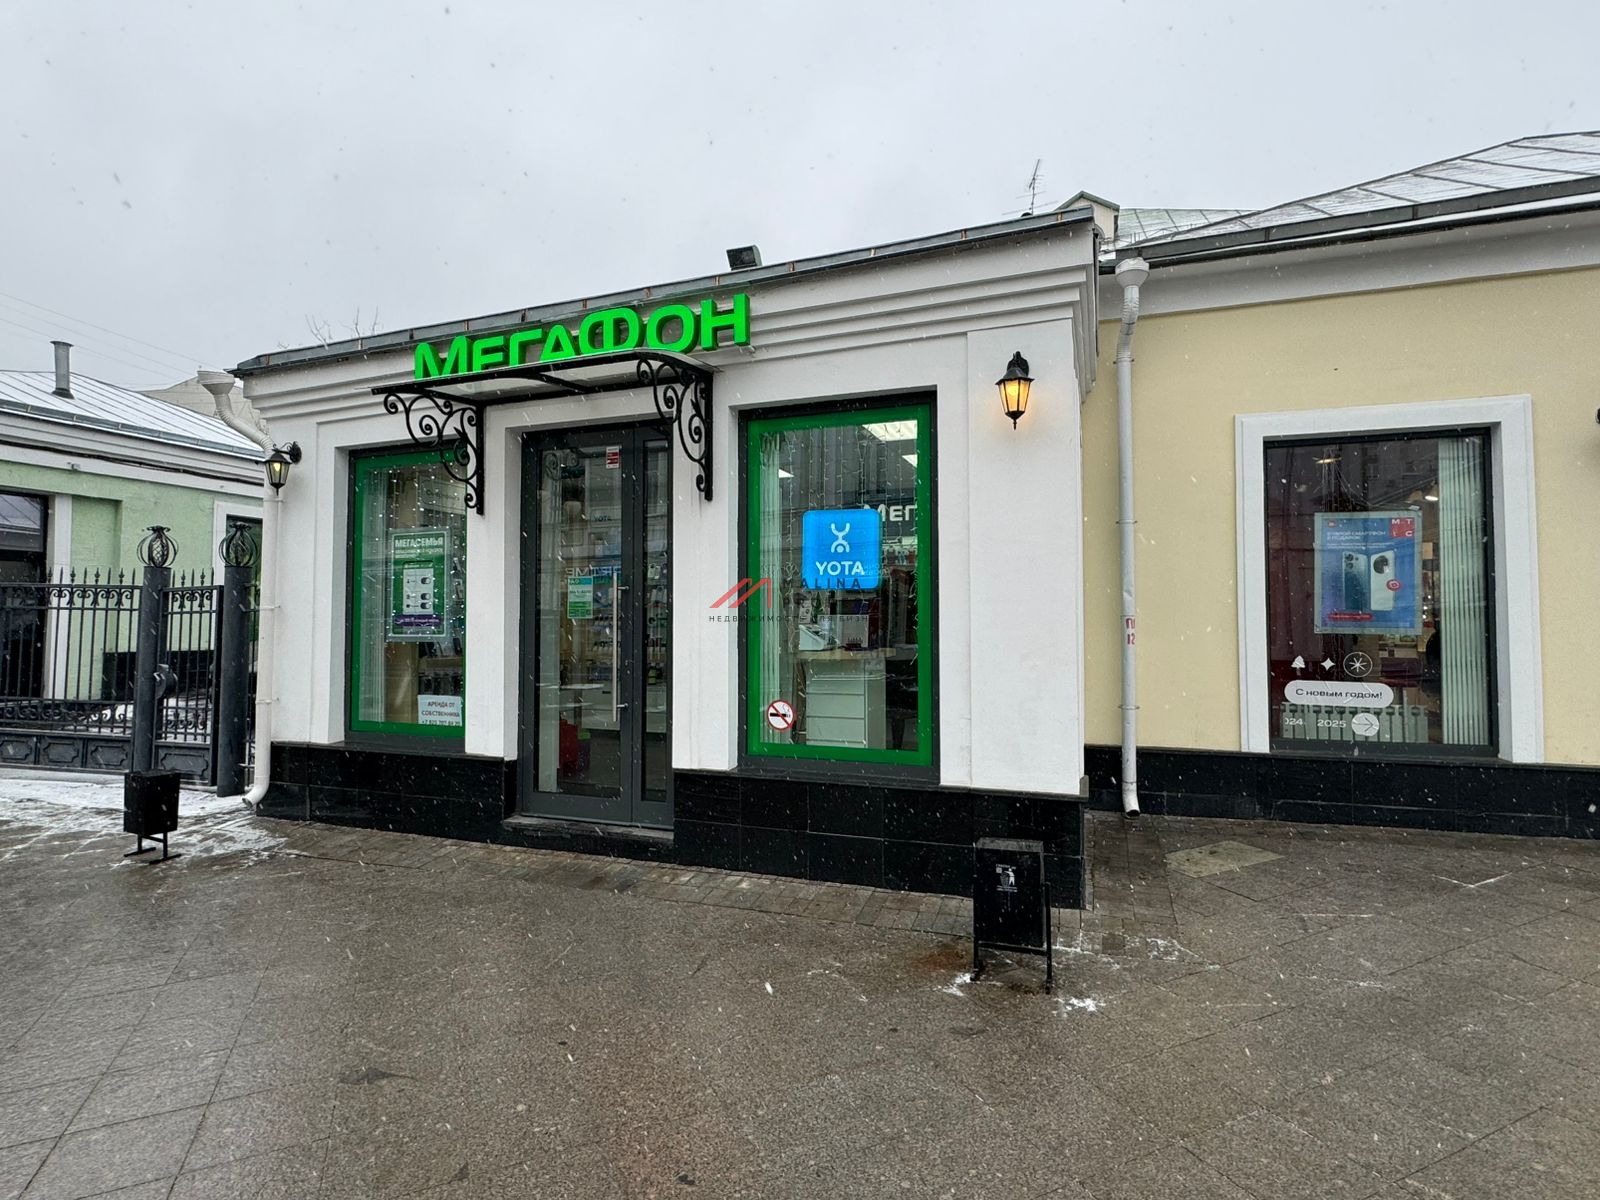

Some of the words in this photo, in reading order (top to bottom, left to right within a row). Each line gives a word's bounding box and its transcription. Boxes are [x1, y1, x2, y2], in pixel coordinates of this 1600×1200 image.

[414, 293, 750, 380] МЕГАФОН
[394, 537, 444, 548] МЕГАСЕМЬЯ
[815, 561, 866, 576] YOTA
[1295, 688, 1304, 696] С
[1305, 690, 1343, 698] новым
[1345, 691, 1383, 700] годом!
[1317, 719, 1347, 728] 2025
